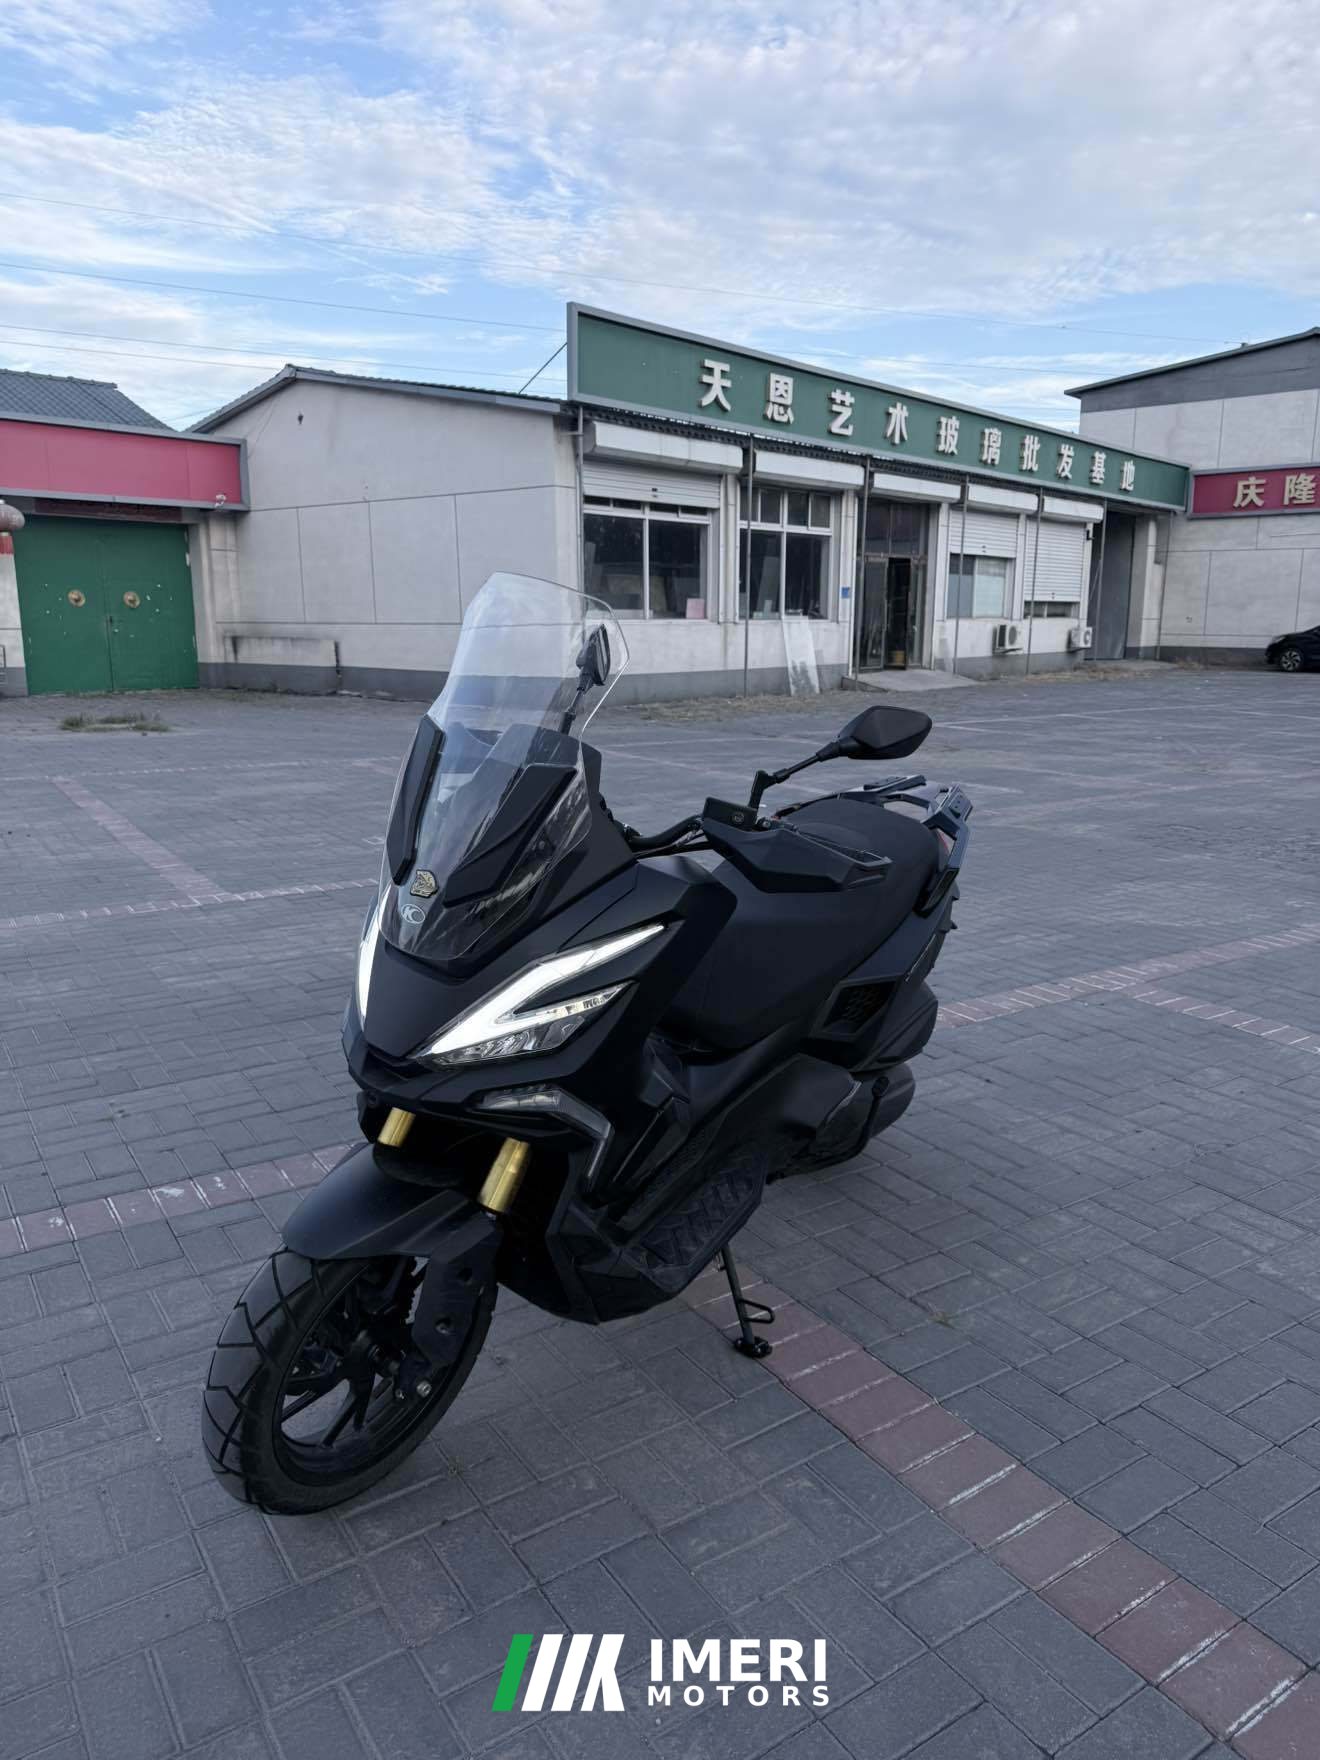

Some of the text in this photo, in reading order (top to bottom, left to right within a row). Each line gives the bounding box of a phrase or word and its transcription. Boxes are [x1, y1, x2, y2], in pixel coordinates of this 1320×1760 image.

[700, 358, 1136, 492] 天恩艺术玻璃批发基地
[1232, 473, 1317, 508] 庆隆
